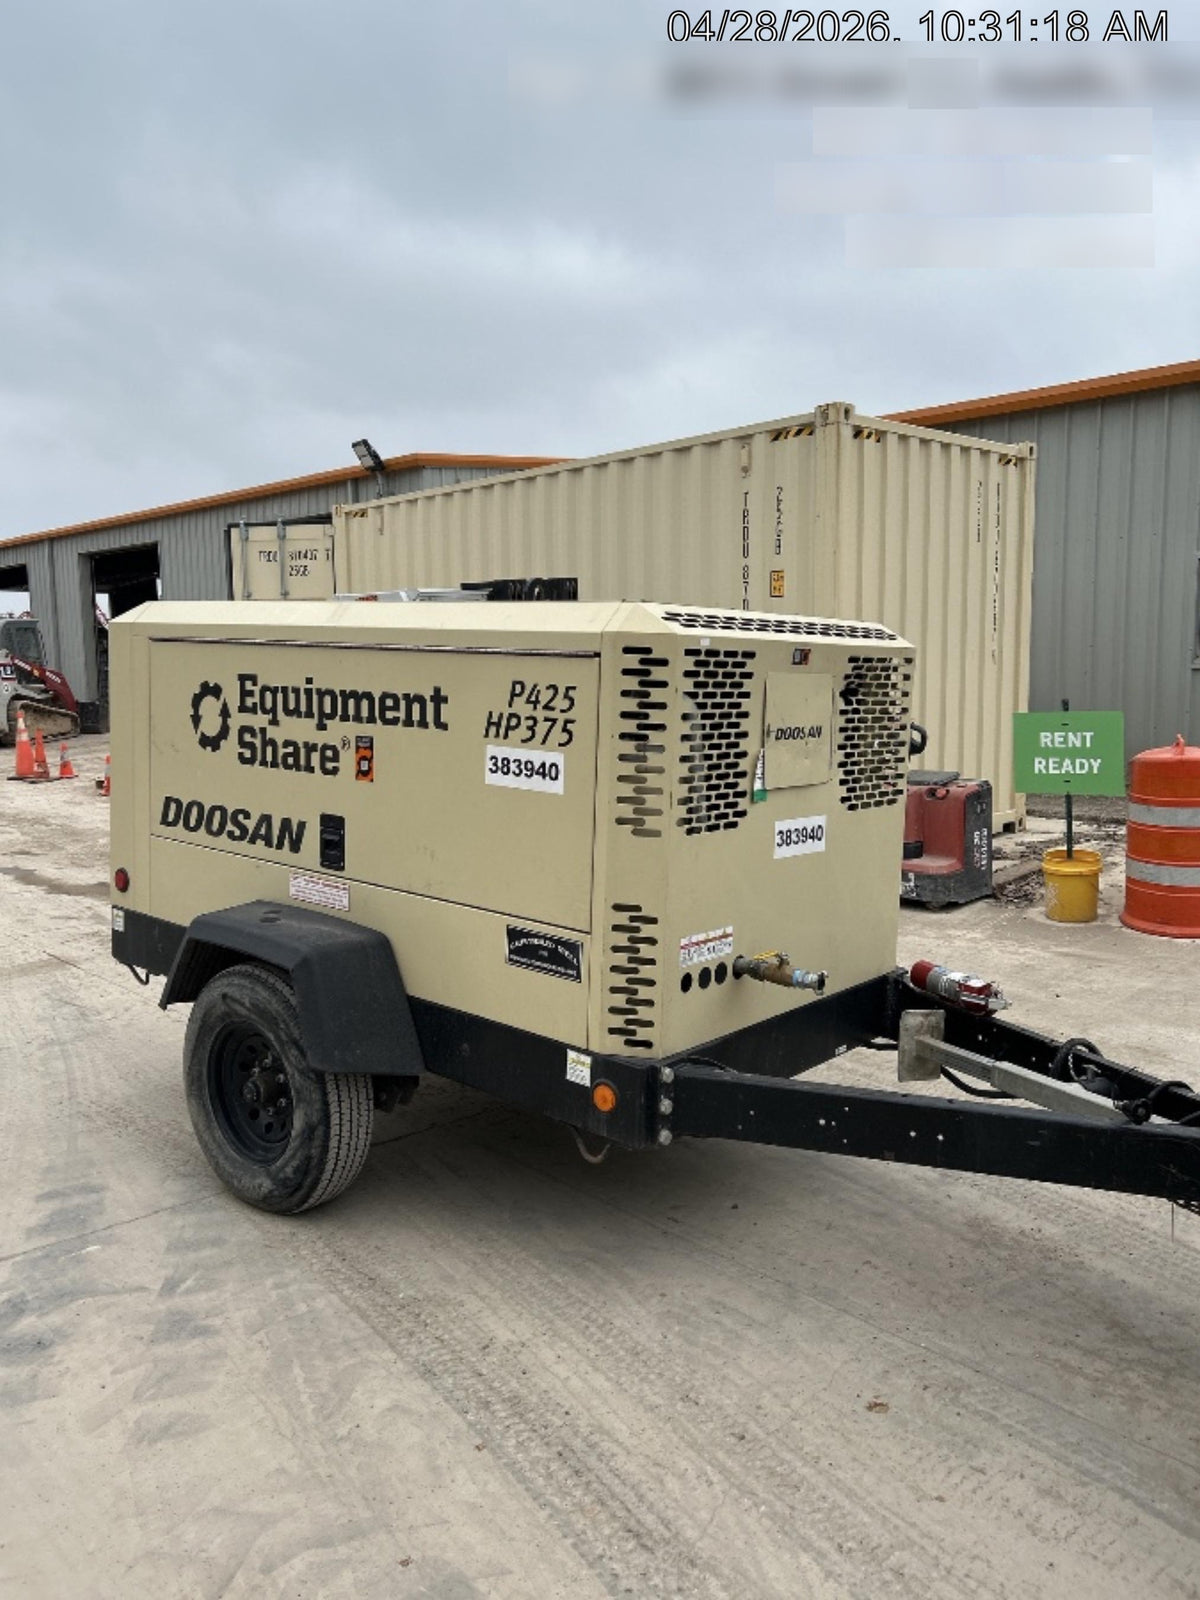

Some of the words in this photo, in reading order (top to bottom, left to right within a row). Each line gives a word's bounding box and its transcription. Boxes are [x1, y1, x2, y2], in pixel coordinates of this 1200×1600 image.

[237, 673, 449, 731] Equipment
[508, 680, 577, 714] P425
[484, 711, 575, 748] HP375
[774, 726, 823, 741] DOOSAN
[1039, 731, 1094, 748] RENT
[487, 754, 560, 783] 383940
[1034, 757, 1102, 775] READY
[159, 796, 307, 854] DOOSAN
[776, 824, 824, 848] 383940
